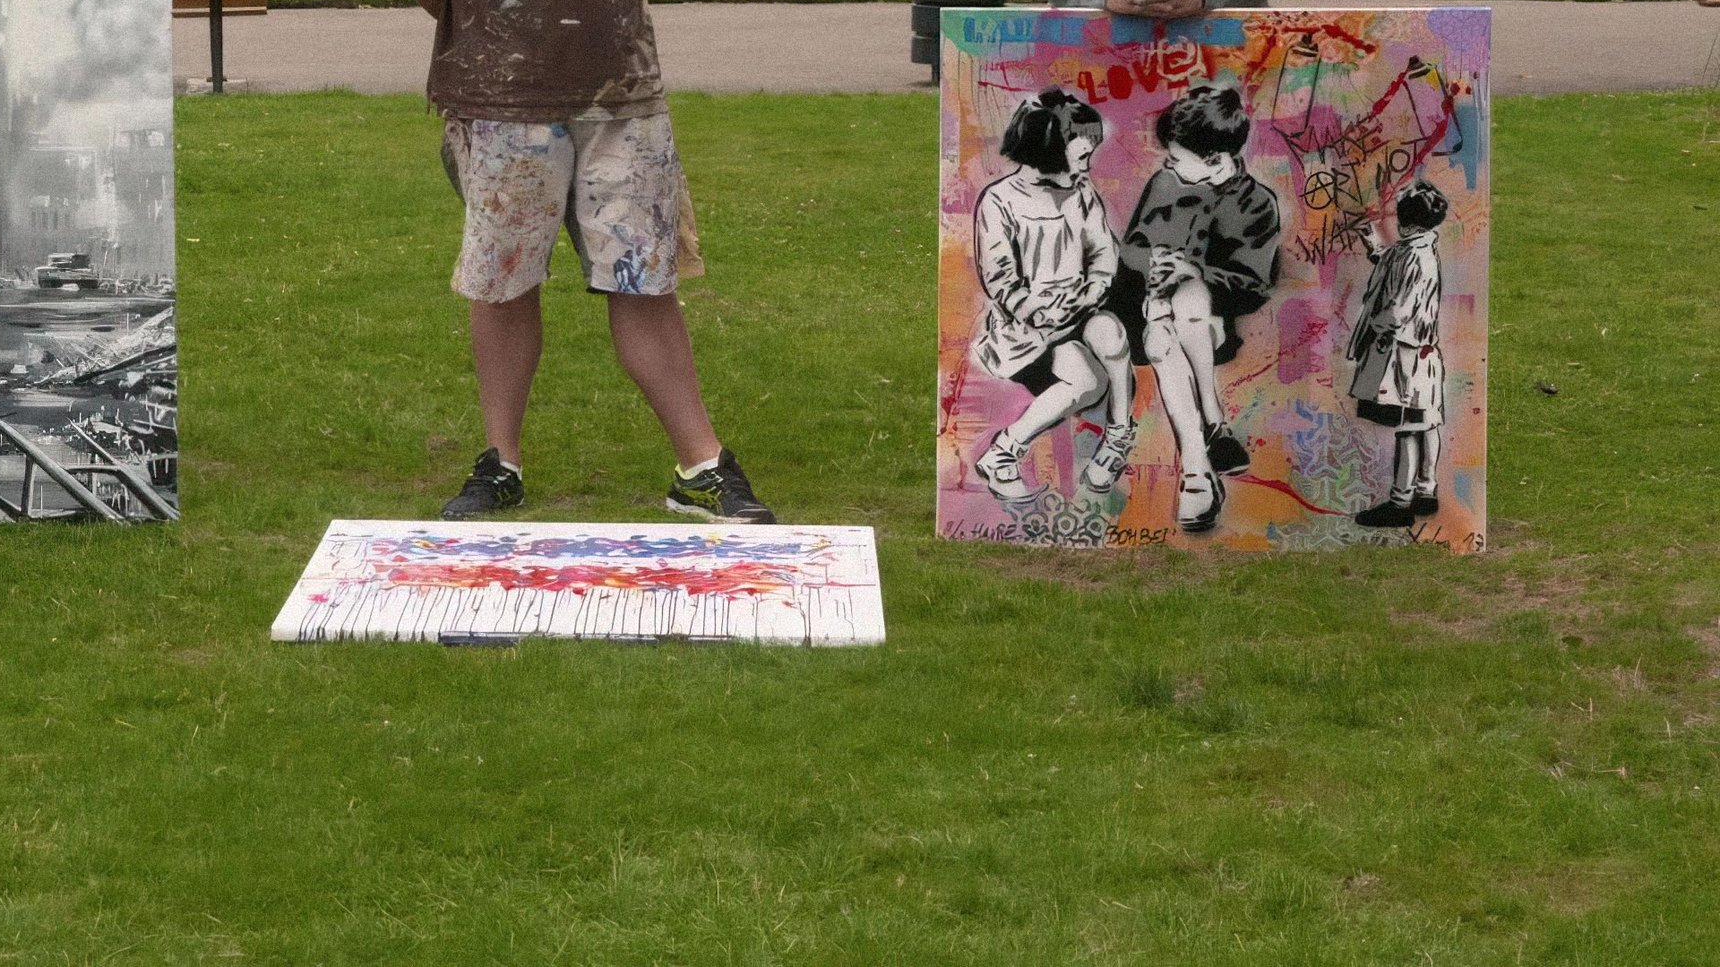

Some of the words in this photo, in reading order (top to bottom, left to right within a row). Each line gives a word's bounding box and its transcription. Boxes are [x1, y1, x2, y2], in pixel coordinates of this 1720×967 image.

[1077, 49, 1194, 105] LOVE
[1300, 160, 1363, 211] ART
[1375, 136, 1430, 196] NOT
[1296, 211, 1366, 265] WAR
